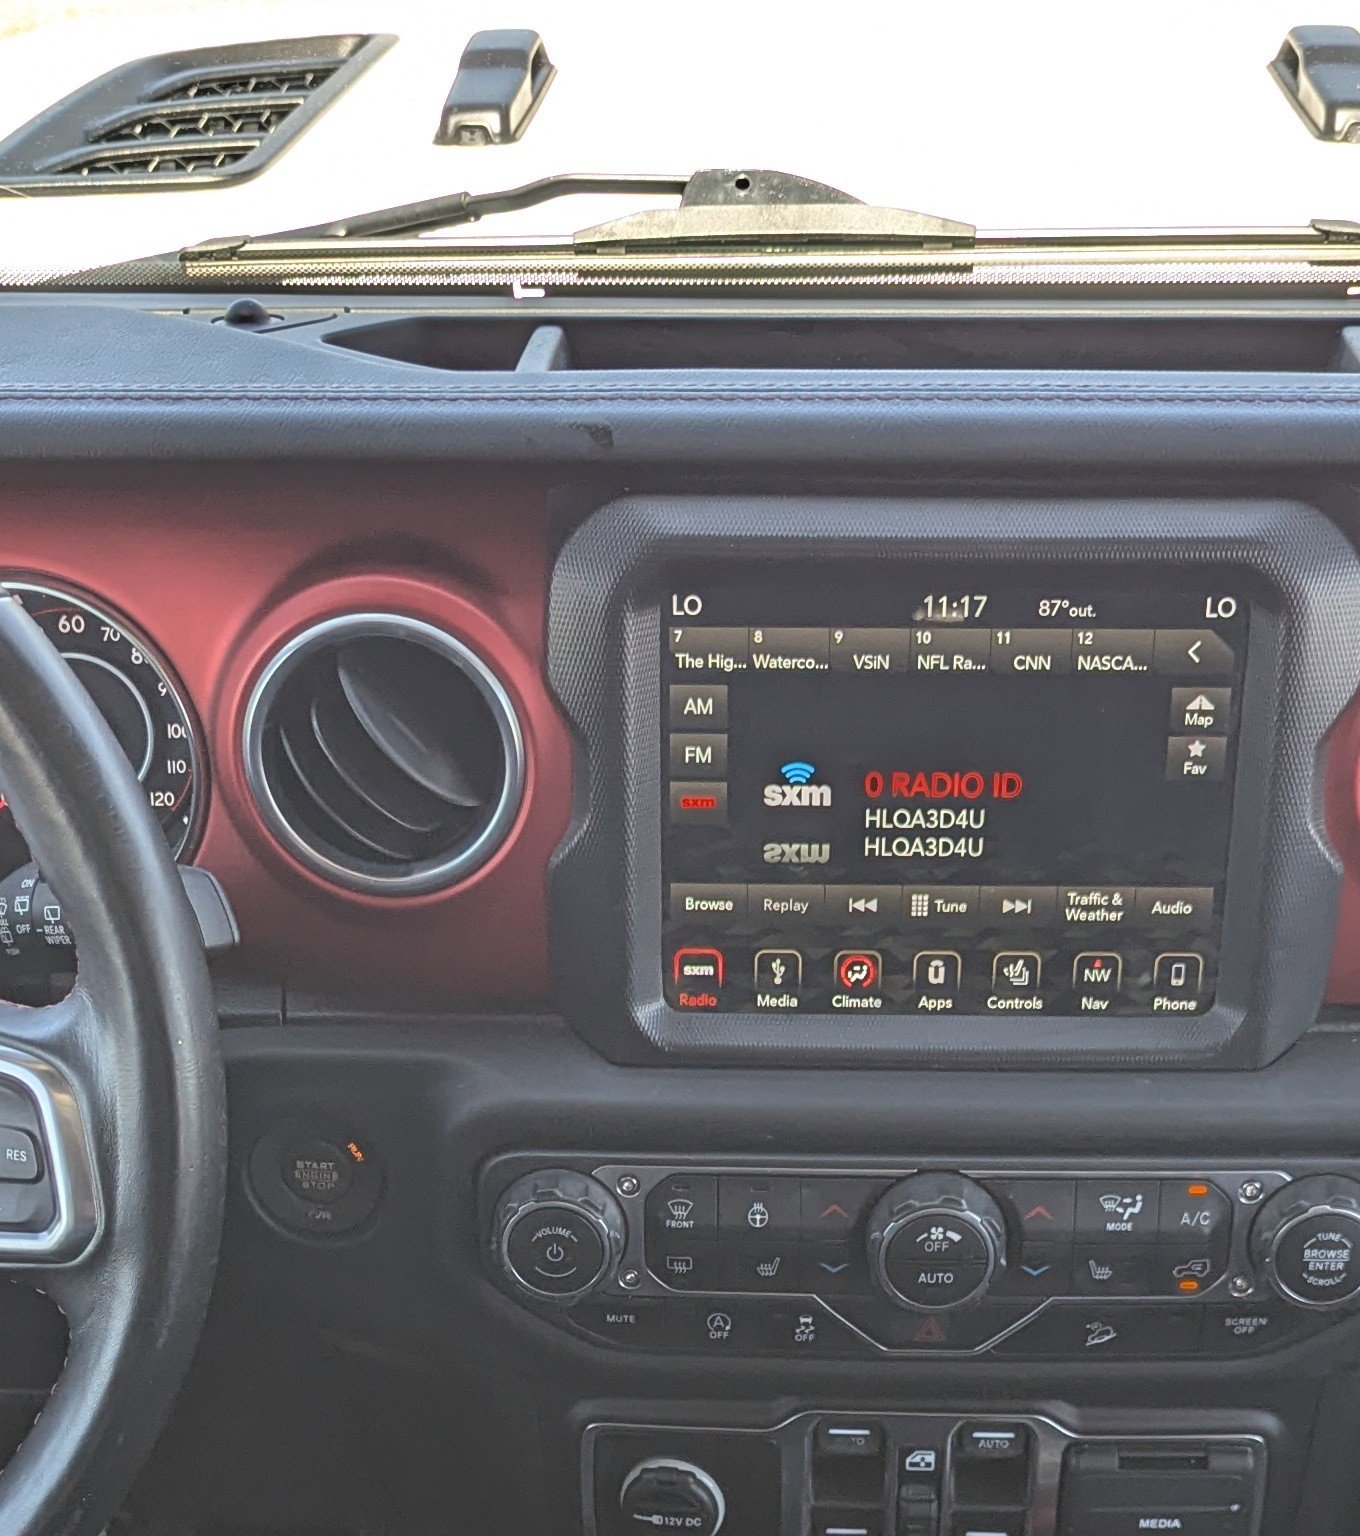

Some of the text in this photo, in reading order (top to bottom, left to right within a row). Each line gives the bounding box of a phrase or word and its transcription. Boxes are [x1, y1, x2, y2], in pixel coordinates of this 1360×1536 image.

[672, 594, 703, 616] LO
[923, 595, 988, 618] 11:17
[1205, 597, 1237, 618] LO
[58, 614, 85, 633] 60
[100, 625, 121, 642] 70
[673, 630, 682, 643] 7
[753, 630, 763, 643] 8
[834, 630, 844, 644] 9
[915, 631, 932, 645] 10
[996, 631, 1011, 645] 11
[1077, 632, 1094, 645] 12
[131, 646, 149, 665] 8
[675, 653, 704, 669] The
[853, 653, 890, 670] VSiN
[917, 654, 986, 671] NFL Ra...
[1013, 654, 1051, 671] CNN
[1077, 655, 1147, 671] NASCA...
[683, 698, 713, 715] AM
[1184, 712, 1214, 729] Map
[685, 746, 712, 763] FM
[167, 760, 186, 775] 110
[1183, 761, 1208, 775] Fav
[864, 771, 1023, 799] 0 RADIO ID
[150, 792, 175, 807] 120
[764, 783, 832, 807] sxm
[681, 796, 718, 809] sxm
[865, 808, 986, 829] HLQA3D4U
[864, 836, 984, 858] HLQA3D4U
[685, 897, 734, 911] Browse
[1067, 891, 1123, 906] Traffic &
[763, 898, 809, 914] Replay
[934, 900, 968, 913] Tune
[1151, 901, 1193, 915] Audio
[1065, 908, 1124, 922] Weather
[16, 923, 31, 934] OFF
[43, 924, 65, 935] REAR
[683, 964, 714, 976] sxm
[1083, 968, 1112, 983] NW
[679, 992, 719, 1007] Radio
[757, 994, 798, 1008] Media
[832, 995, 882, 1009] Climate
[918, 996, 953, 1010] Apps
[987, 995, 1043, 1011] Controls
[1081, 996, 1109, 1011] Nav
[1153, 996, 1198, 1012] Phone
[5, 1149, 28, 1162] RES
[665, 1220, 695, 1229] FRONT
[1180, 1211, 1211, 1227] A/C
[536, 1226, 573, 1239] VOLUME
[1106, 1222, 1133, 1231] MODE
[1317, 1232, 1342, 1242] TUNE
[924, 1241, 950, 1252] OFF
[1303, 1248, 1351, 1259] BROWSE
[1308, 1262, 1345, 1271] ENTER
[918, 1272, 954, 1284] AUTO
[606, 1314, 636, 1324] MUTE
[1224, 1317, 1267, 1326] SCREEN
[709, 1331, 729, 1339] OFF
[794, 1333, 815, 1342] OFF
[978, 1440, 1010, 1449] AUTO
[664, 1516, 702, 1527] 12V DC
[1139, 1518, 1181, 1530] MEDIA
